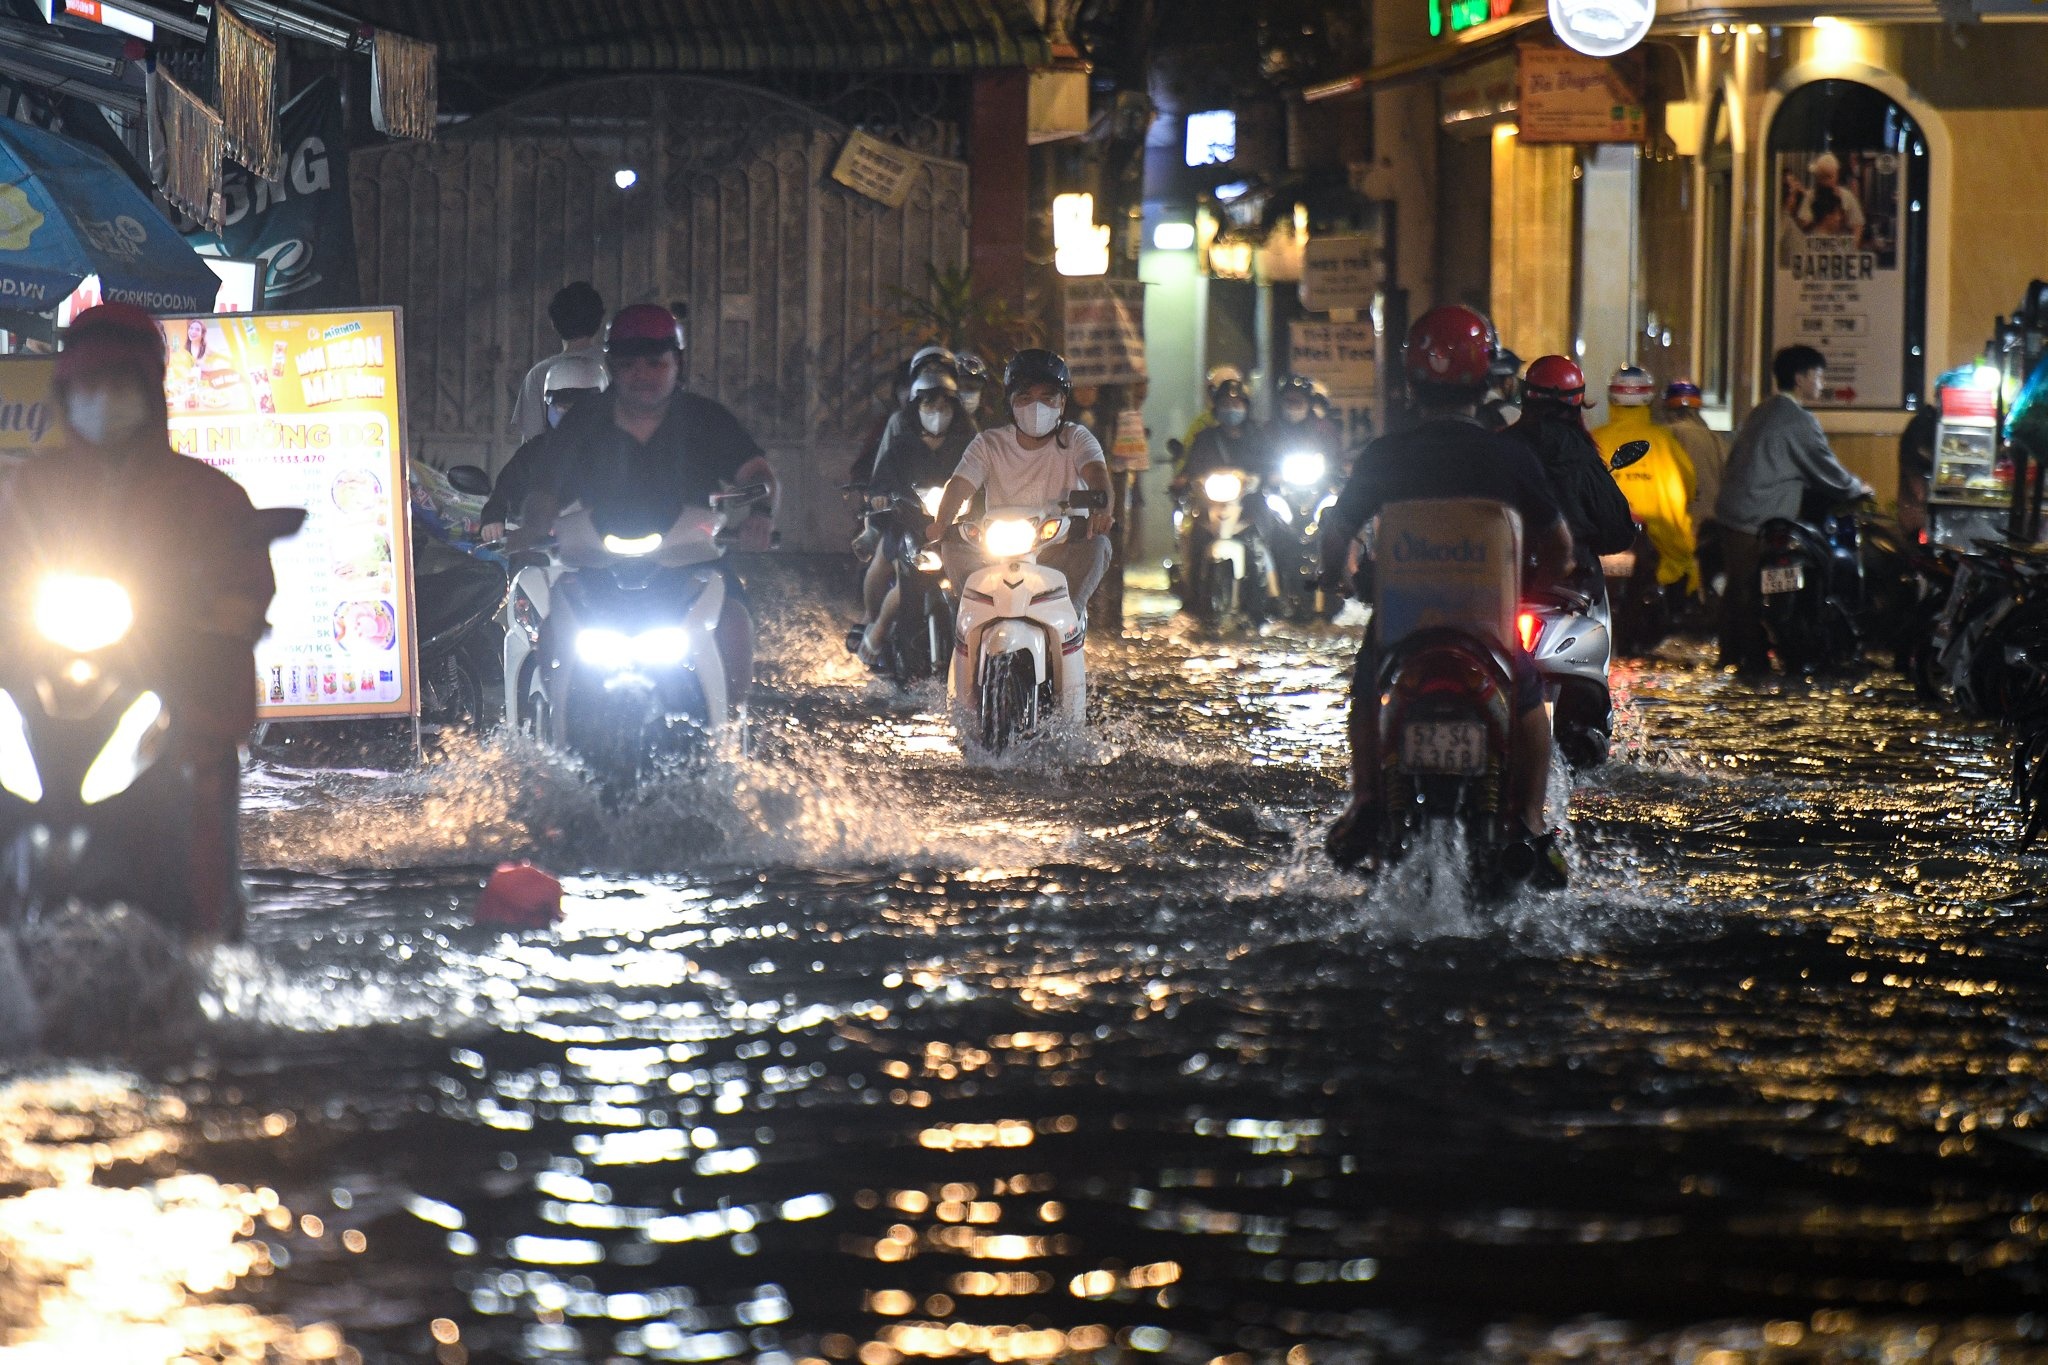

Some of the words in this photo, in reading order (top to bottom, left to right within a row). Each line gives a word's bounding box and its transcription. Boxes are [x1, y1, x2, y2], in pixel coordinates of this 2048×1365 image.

[1791, 254, 1873, 281] BARBER
[107, 287, 198, 311] TORKIFOOD.VN
[312, 615, 330, 623] 12K
[317, 629, 331, 638] 5K
